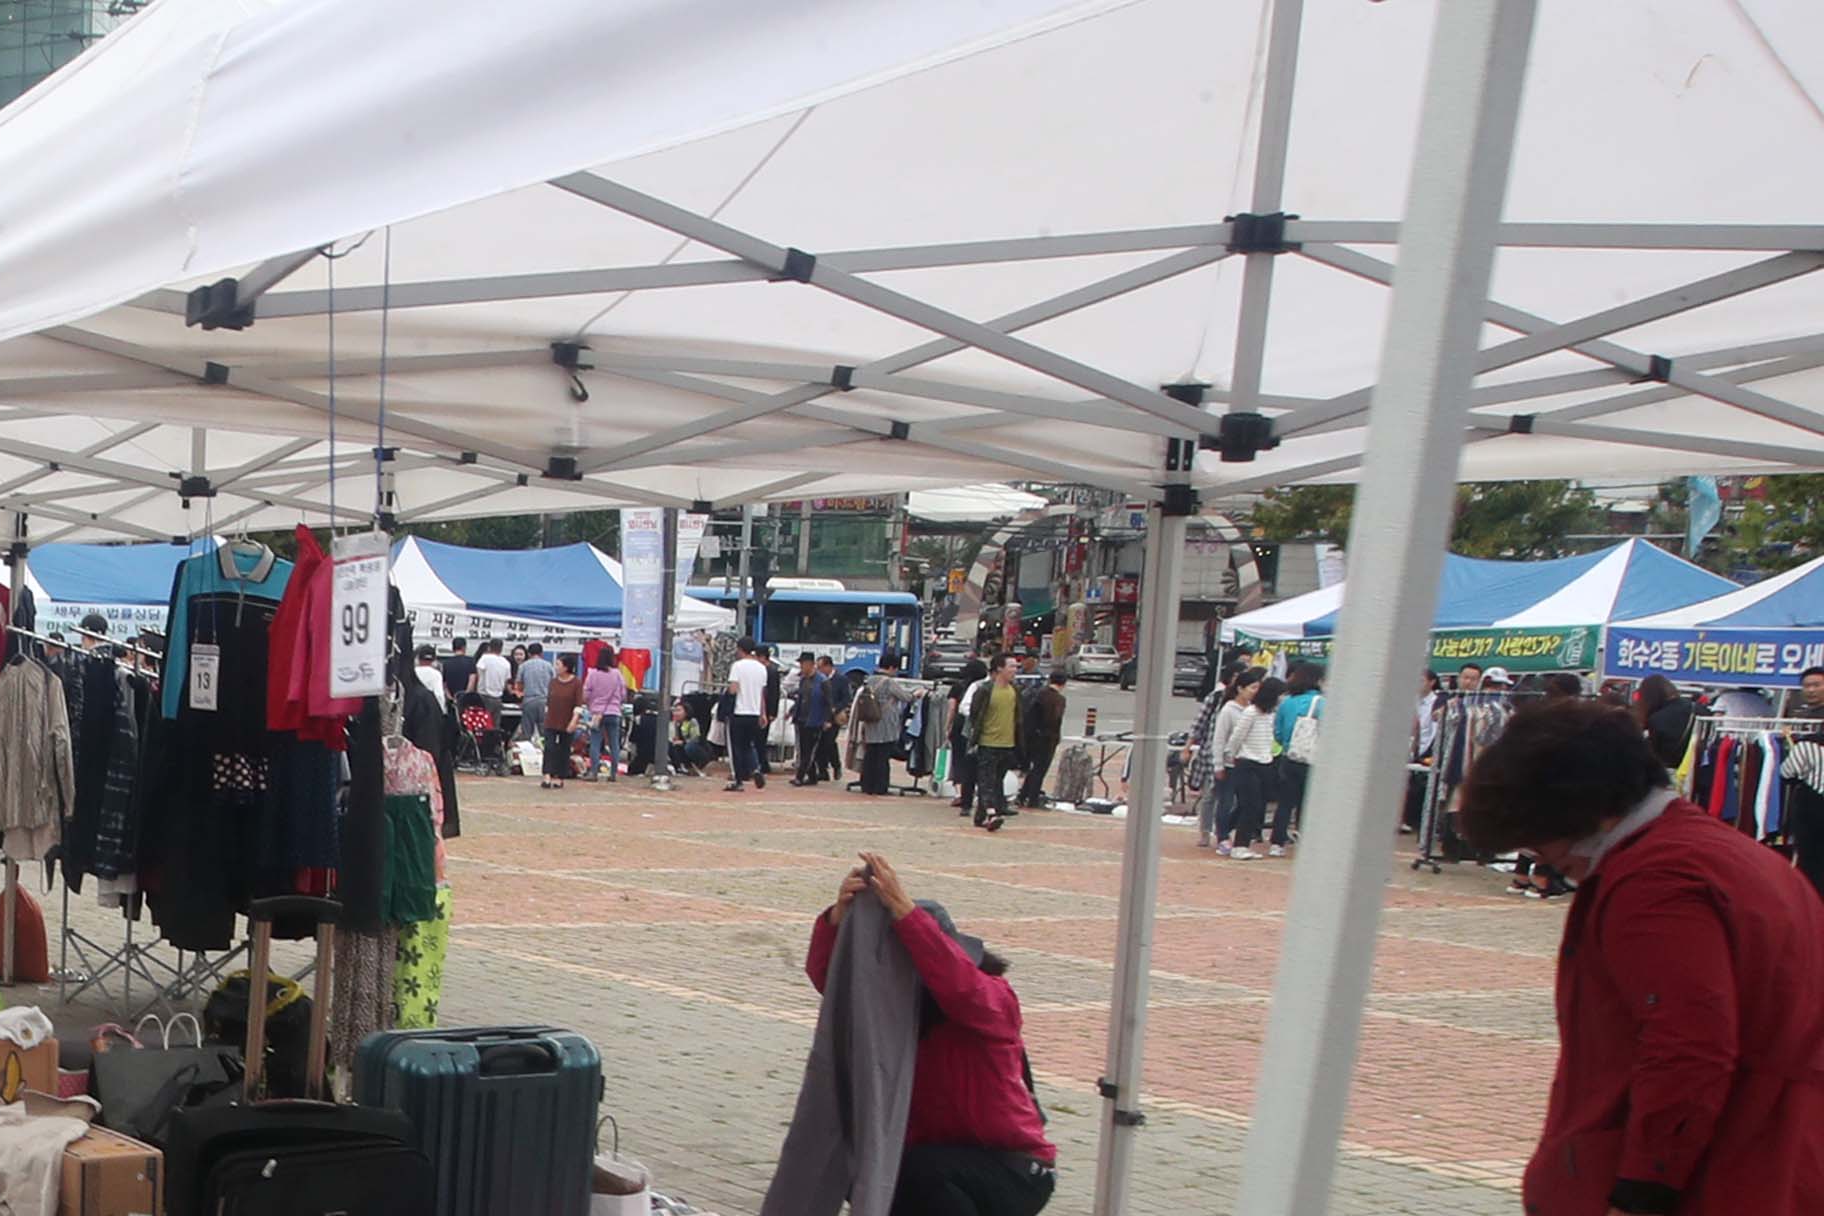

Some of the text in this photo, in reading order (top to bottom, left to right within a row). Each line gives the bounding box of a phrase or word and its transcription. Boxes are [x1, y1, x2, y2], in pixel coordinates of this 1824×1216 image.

[342, 602, 370, 646] 99
[1617, 638, 1680, 671] 화수2동
[196, 671, 211, 690] 13
